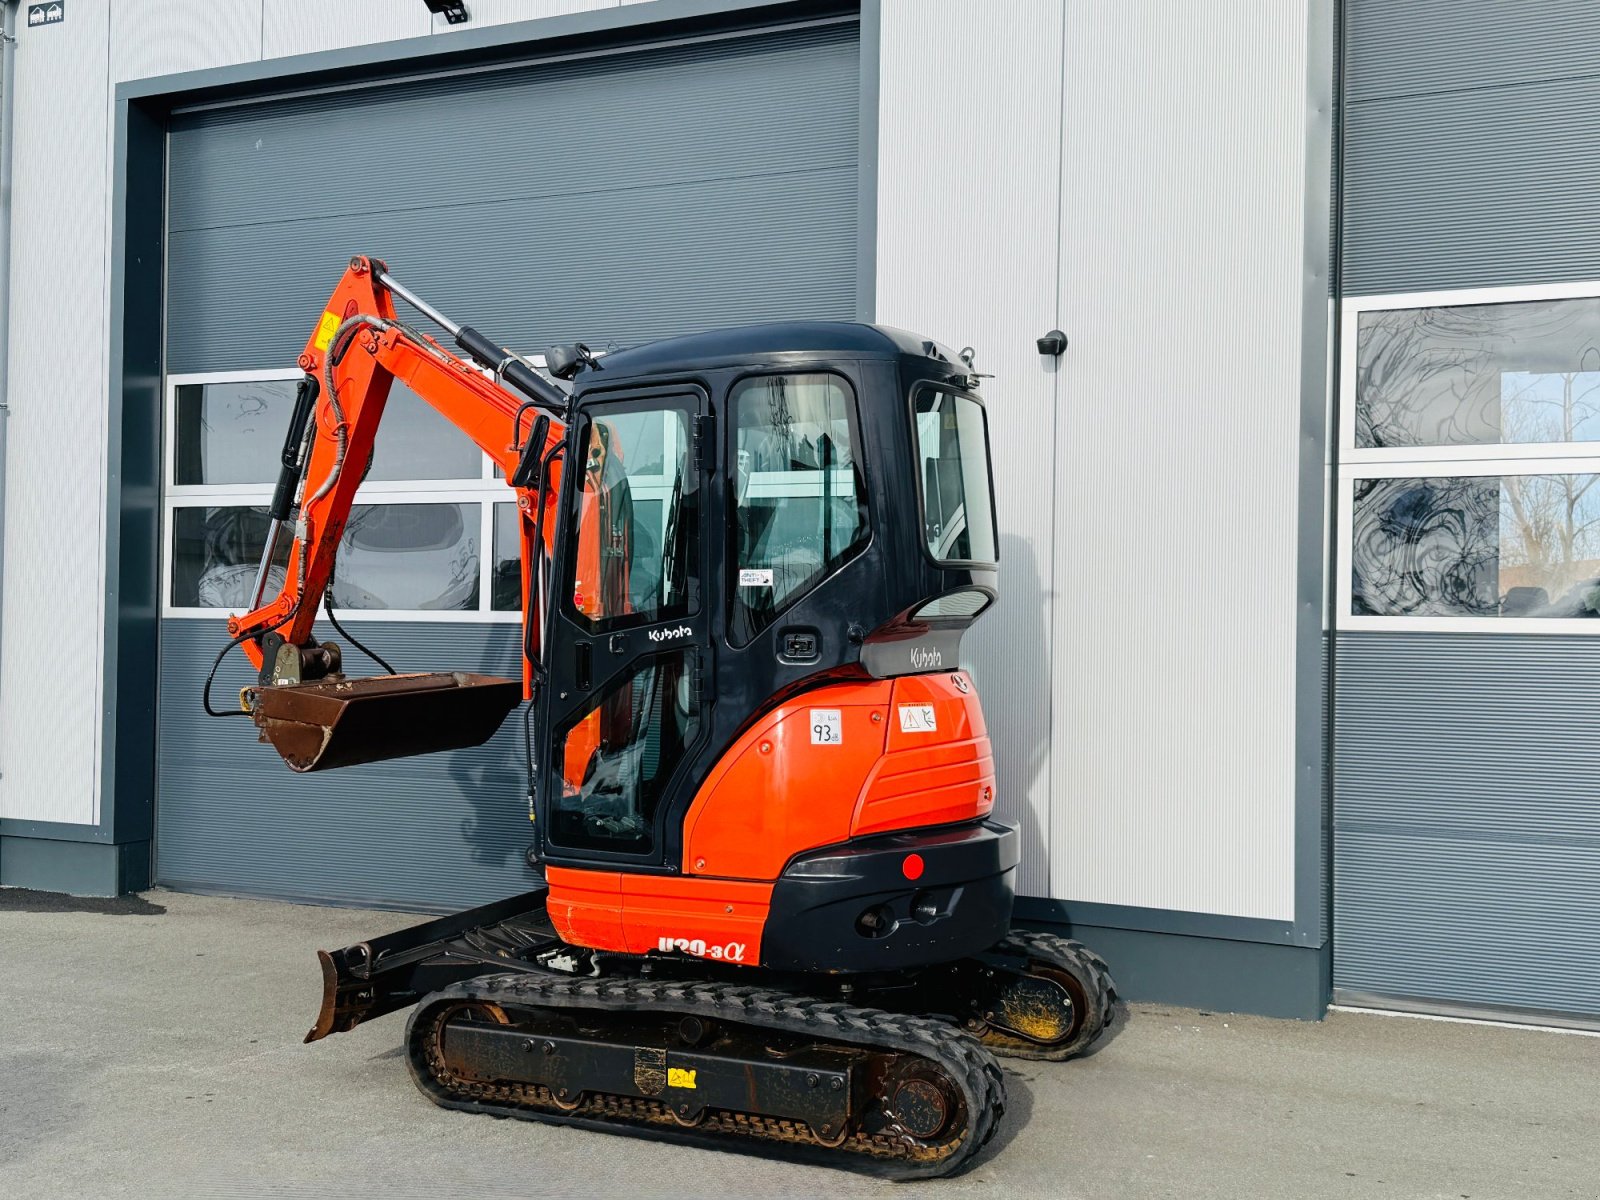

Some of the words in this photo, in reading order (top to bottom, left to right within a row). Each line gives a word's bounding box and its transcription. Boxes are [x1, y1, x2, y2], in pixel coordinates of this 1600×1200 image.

[648, 625, 693, 642] Kubota
[910, 646, 942, 669] Kubota
[814, 724, 831, 742] 93
